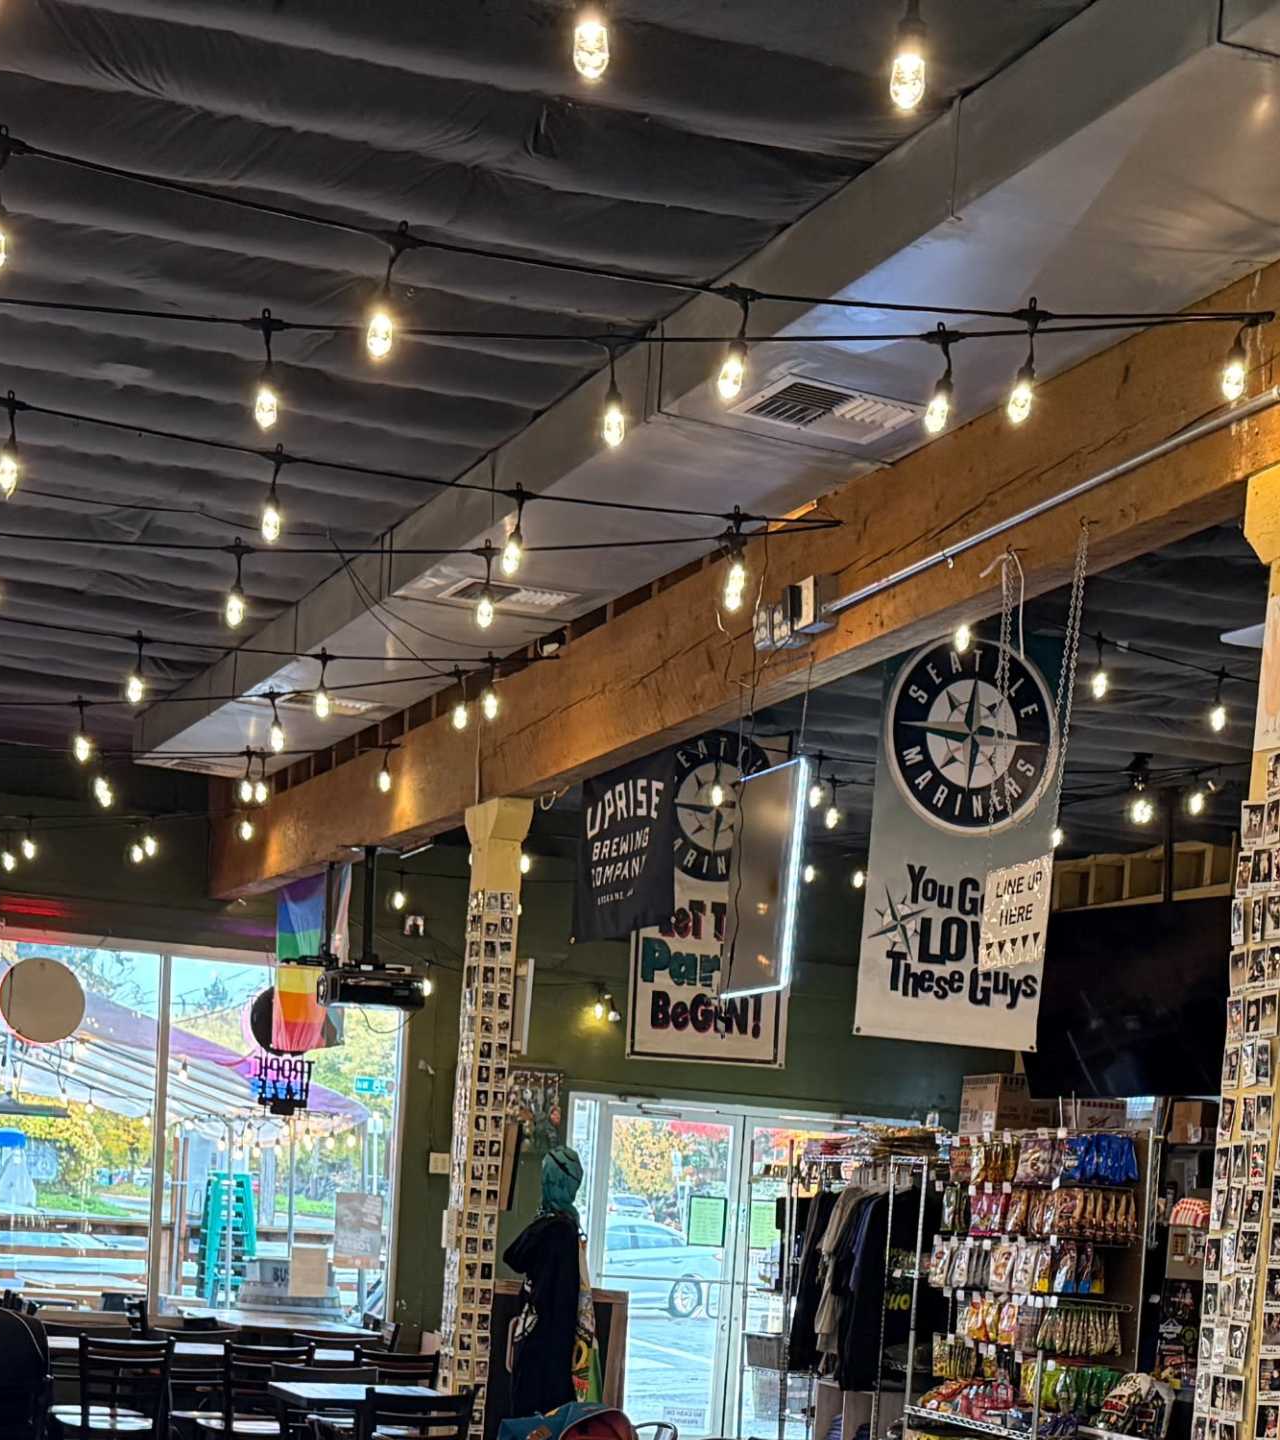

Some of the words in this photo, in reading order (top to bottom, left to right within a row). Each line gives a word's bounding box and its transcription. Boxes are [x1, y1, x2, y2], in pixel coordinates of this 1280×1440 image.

[909, 650, 1039, 718] SEATLE
[902, 745, 1035, 817] MARINERS
[586, 778, 665, 840] UPRISE
[592, 826, 649, 861] BREWING
[591, 854, 648, 888] COMPANY
[907, 864, 954, 909] You
[995, 876, 1025, 899] LINE
[1027, 870, 1043, 891] UP
[999, 903, 1034, 927] HERE
[641, 937, 720, 987] Par
[918, 916, 981, 965] LO
[886, 949, 964, 1000] These
[968, 966, 1038, 1010] Guys
